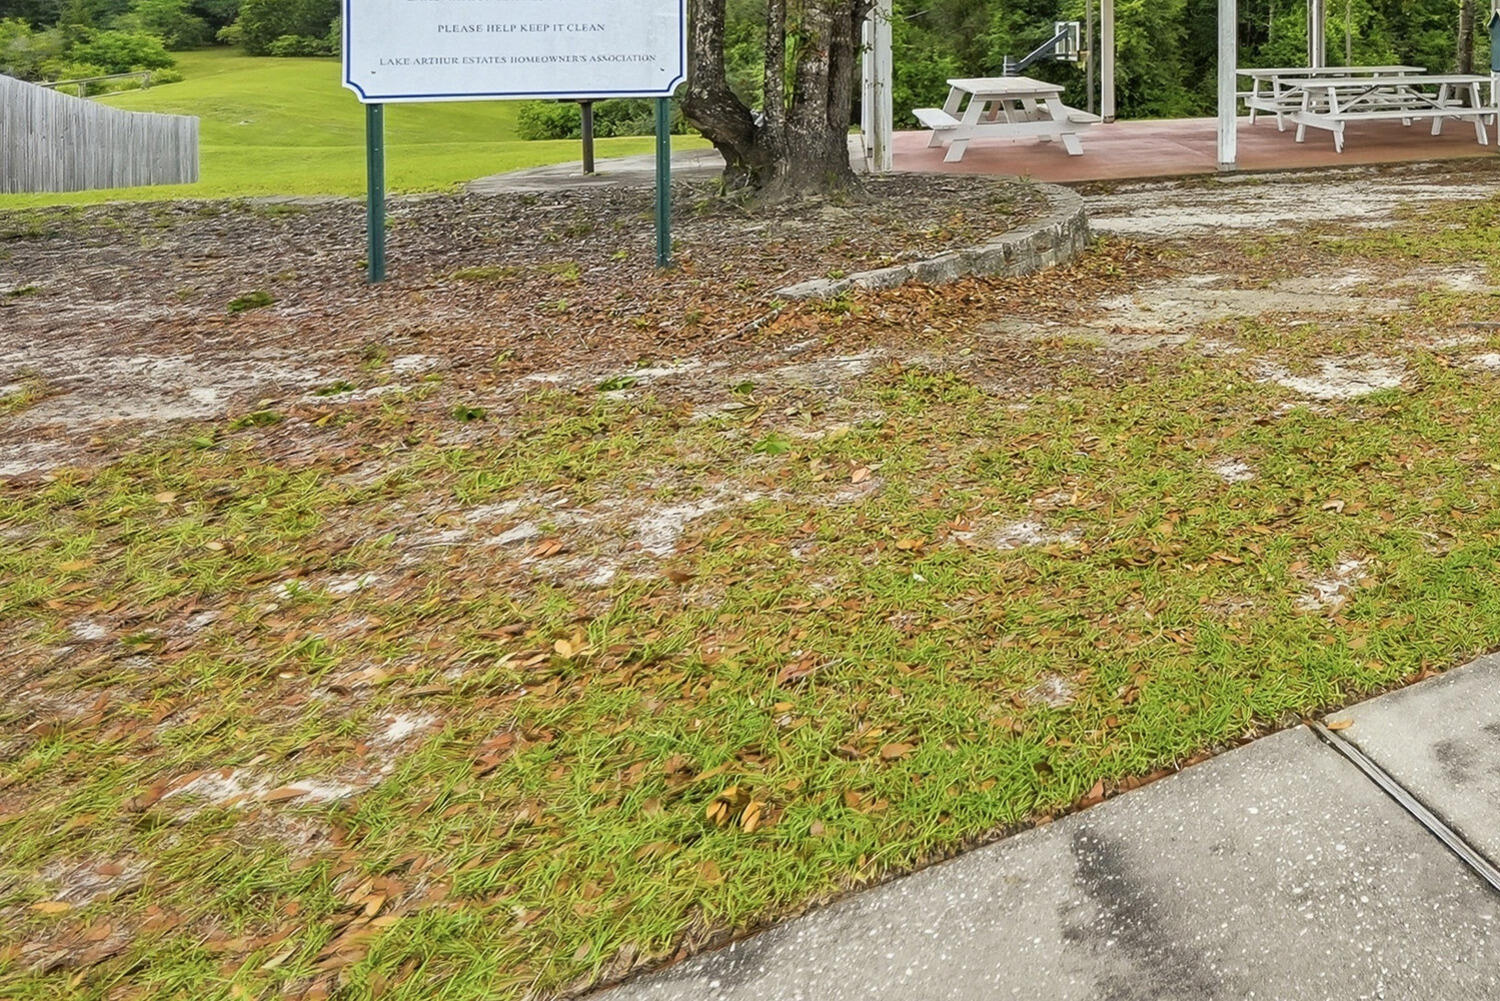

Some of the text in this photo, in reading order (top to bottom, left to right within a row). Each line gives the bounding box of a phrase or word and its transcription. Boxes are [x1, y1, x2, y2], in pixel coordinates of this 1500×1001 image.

[437, 23, 606, 33] PLEASE HELP KEEP IT CLEAN
[379, 54, 657, 66] LAKE ARTHUR ESTATES HOMEOWNER'S ASSOCIATION
